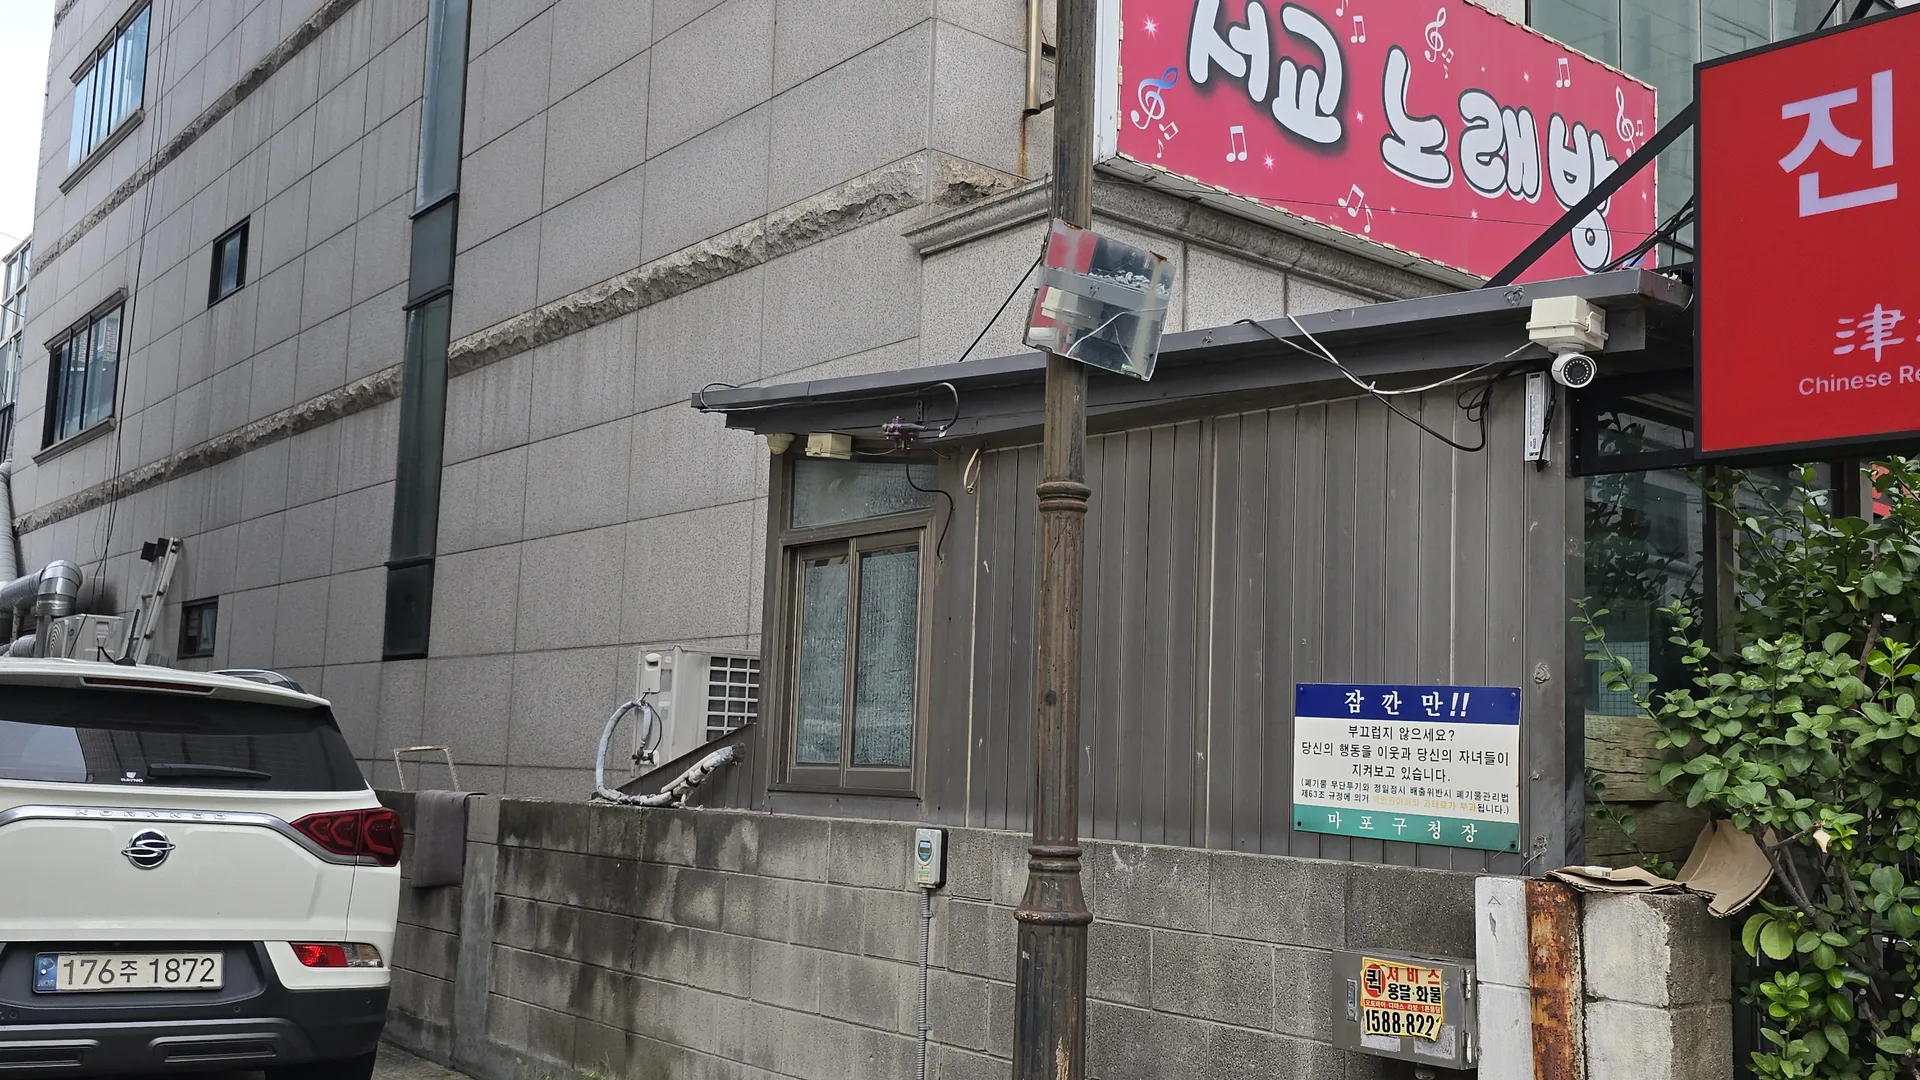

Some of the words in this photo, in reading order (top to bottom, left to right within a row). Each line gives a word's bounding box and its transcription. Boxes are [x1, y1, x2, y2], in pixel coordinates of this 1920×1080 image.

[1188, 0, 1343, 143] 서교
[1380, 45, 1620, 274] 노래방
[1778, 69, 1898, 217] 진
[1833, 303, 1920, 362] 津
[1799, 371, 1892, 395] Chinese
[1348, 725, 1393, 740] 부끄럽지
[1399, 727, 1455, 741] 않으세요?
[1302, 742, 1333, 756] 당신의
[1339, 744, 1371, 758] 행동을
[1378, 746, 1411, 761] 이웃과
[1418, 748, 1452, 763] 당신의
[1459, 751, 1509, 766] 자녀들이
[1352, 764, 1395, 779] 지켜보고
[1401, 767, 1450, 782] 있습니다.
[1301, 789, 1325, 800] 제63조
[1328, 792, 1350, 802] 규정에
[1354, 793, 1369, 803] 의거
[1331, 781, 1370, 792] 무단투기와
[1410, 786, 1451, 799] 배출위반시
[63, 959, 138, 985] 176주
[149, 958, 215, 984] 1872
